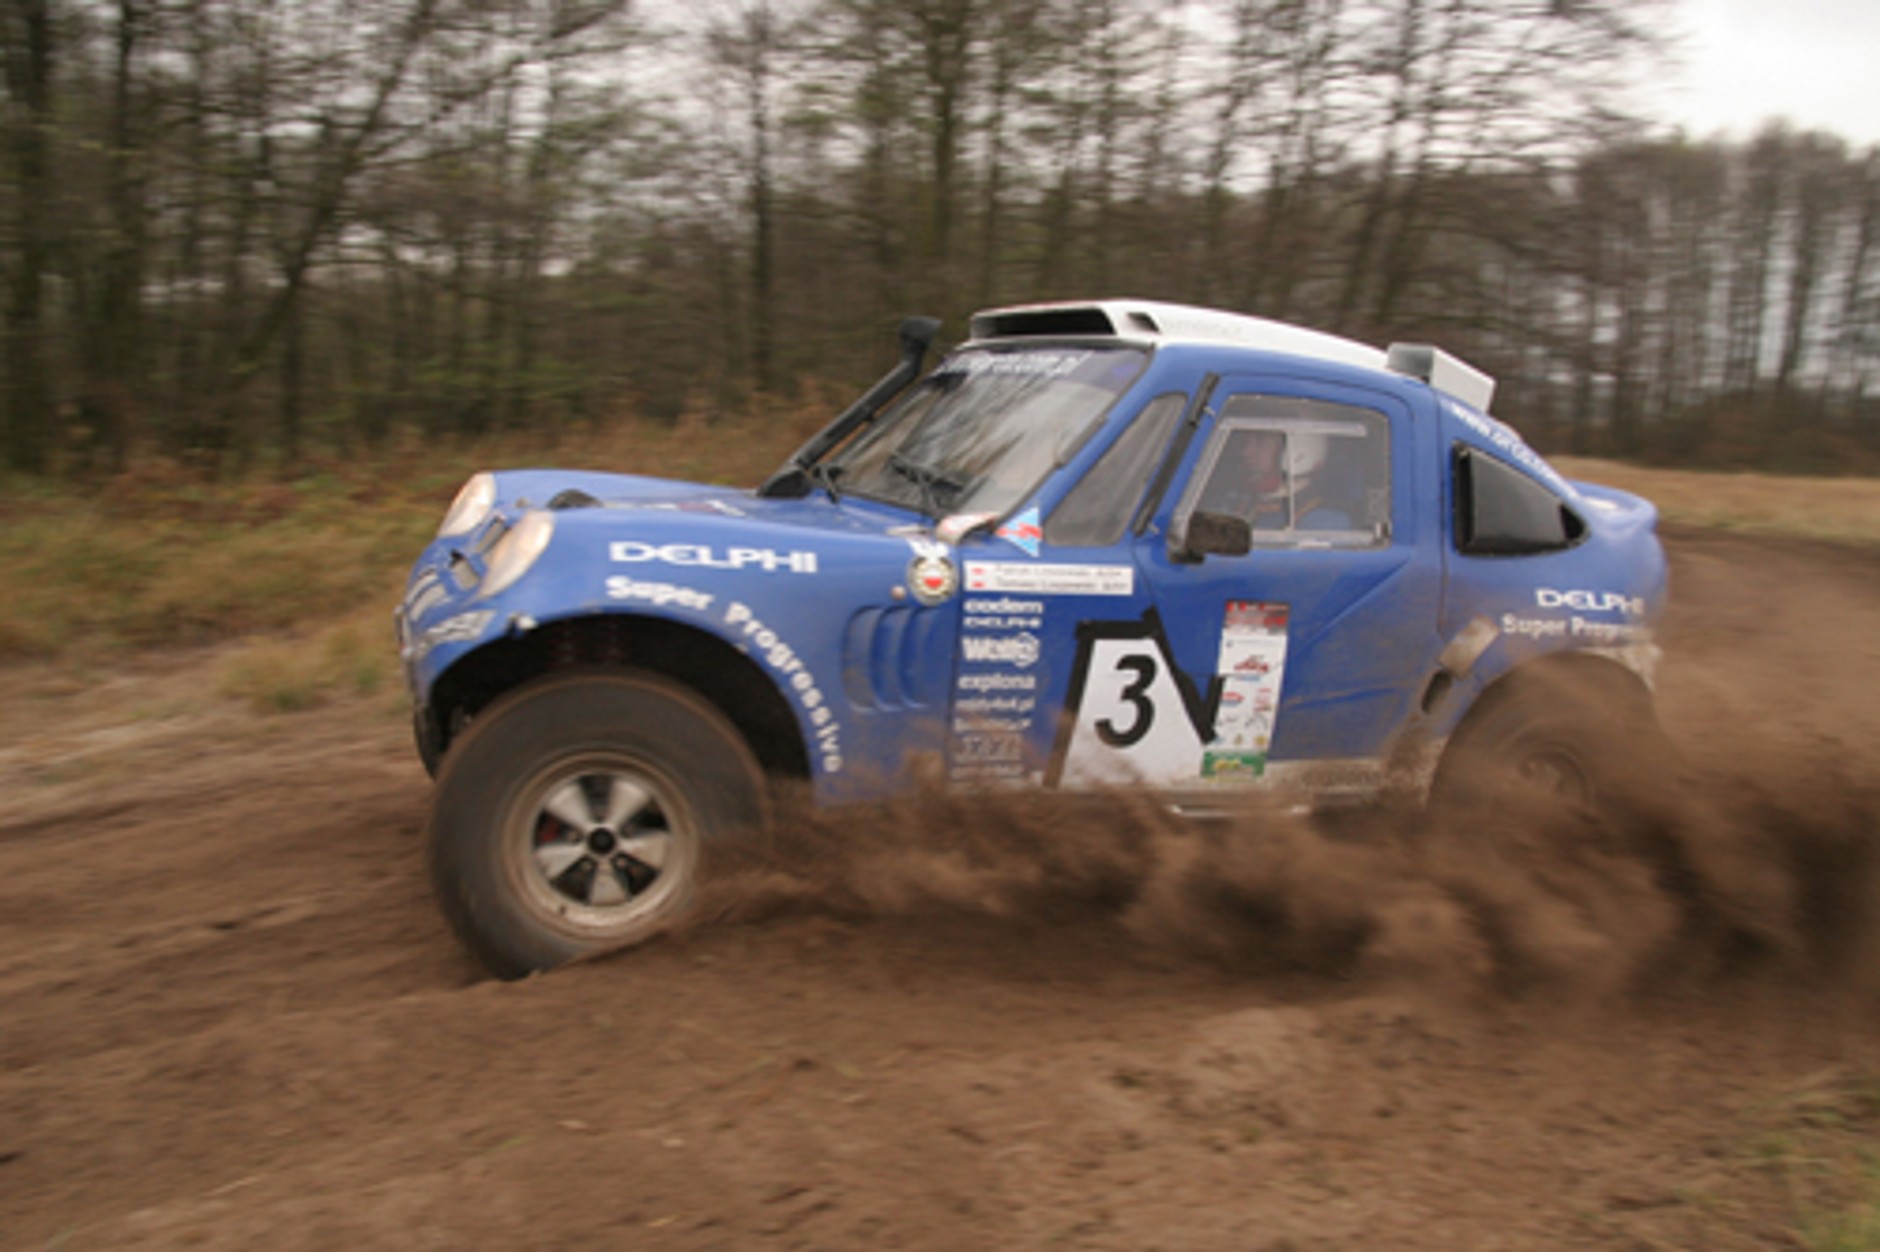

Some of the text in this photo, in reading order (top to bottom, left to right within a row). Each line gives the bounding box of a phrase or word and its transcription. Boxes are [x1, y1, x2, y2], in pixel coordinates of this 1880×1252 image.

[609, 541, 817, 573] DELPHI
[1536, 588, 1645, 615] DELPHI
[963, 617, 1042, 628] DELPHI
[1502, 614, 1566, 640] Super
[606, 576, 842, 772] Super Progressive
[1095, 654, 1157, 748] 3
